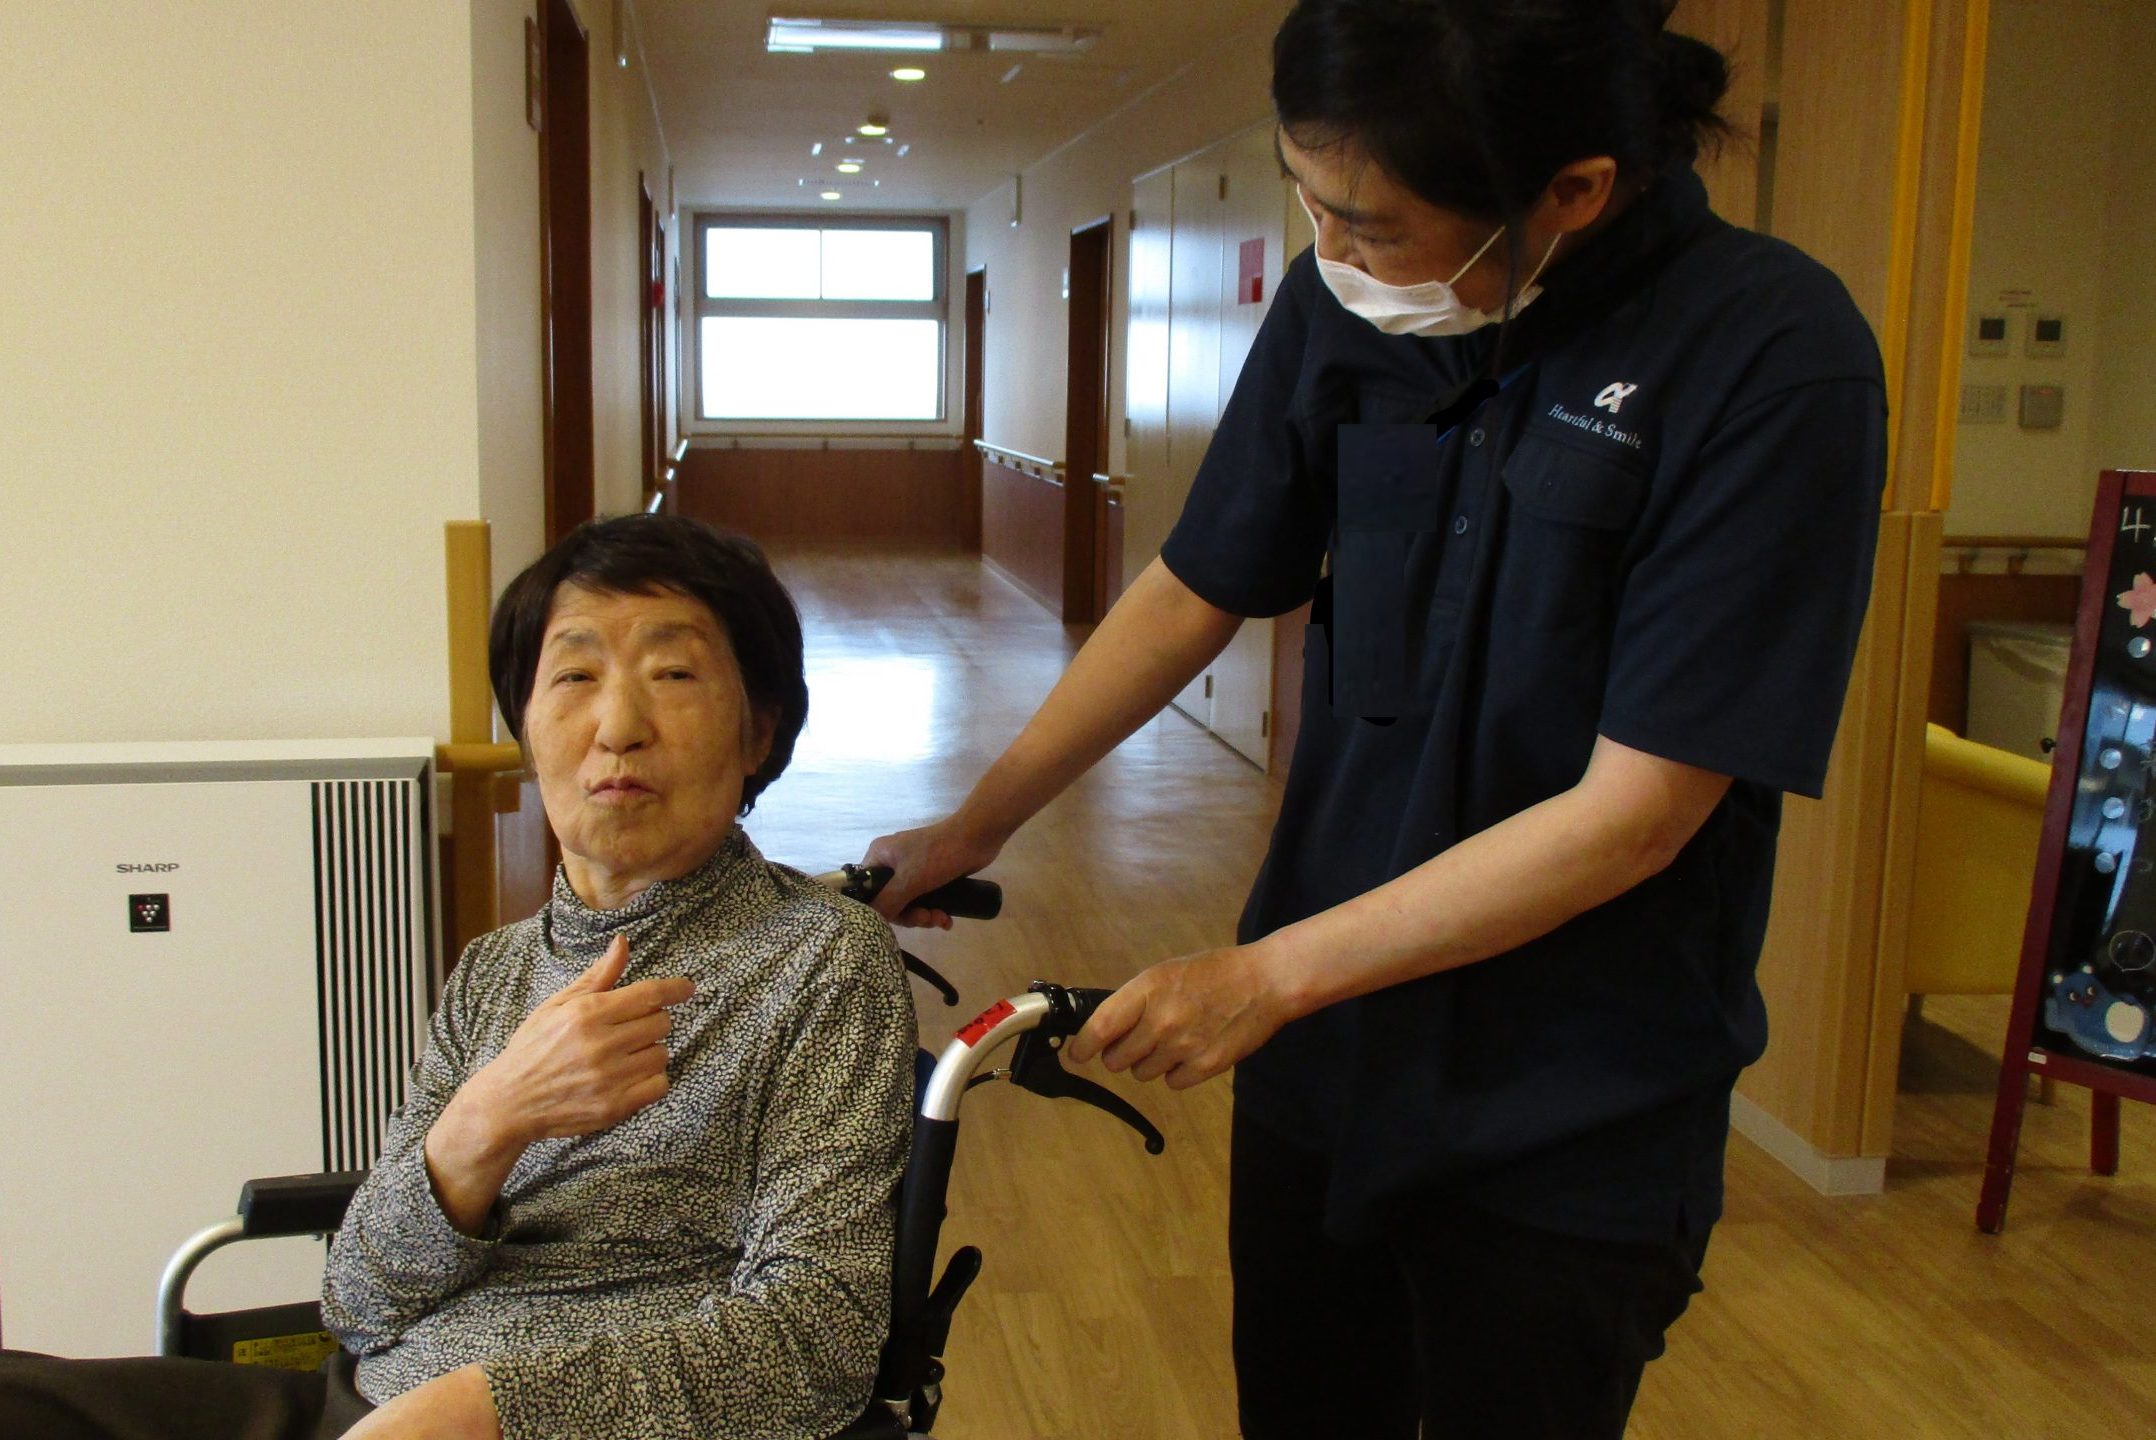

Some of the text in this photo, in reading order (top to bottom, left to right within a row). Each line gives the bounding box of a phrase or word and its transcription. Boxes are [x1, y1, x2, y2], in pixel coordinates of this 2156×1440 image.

[1548, 404, 1642, 449] Heartful & Smile
[2120, 506, 2156, 545] 4
[116, 863, 180, 873] SHARP
